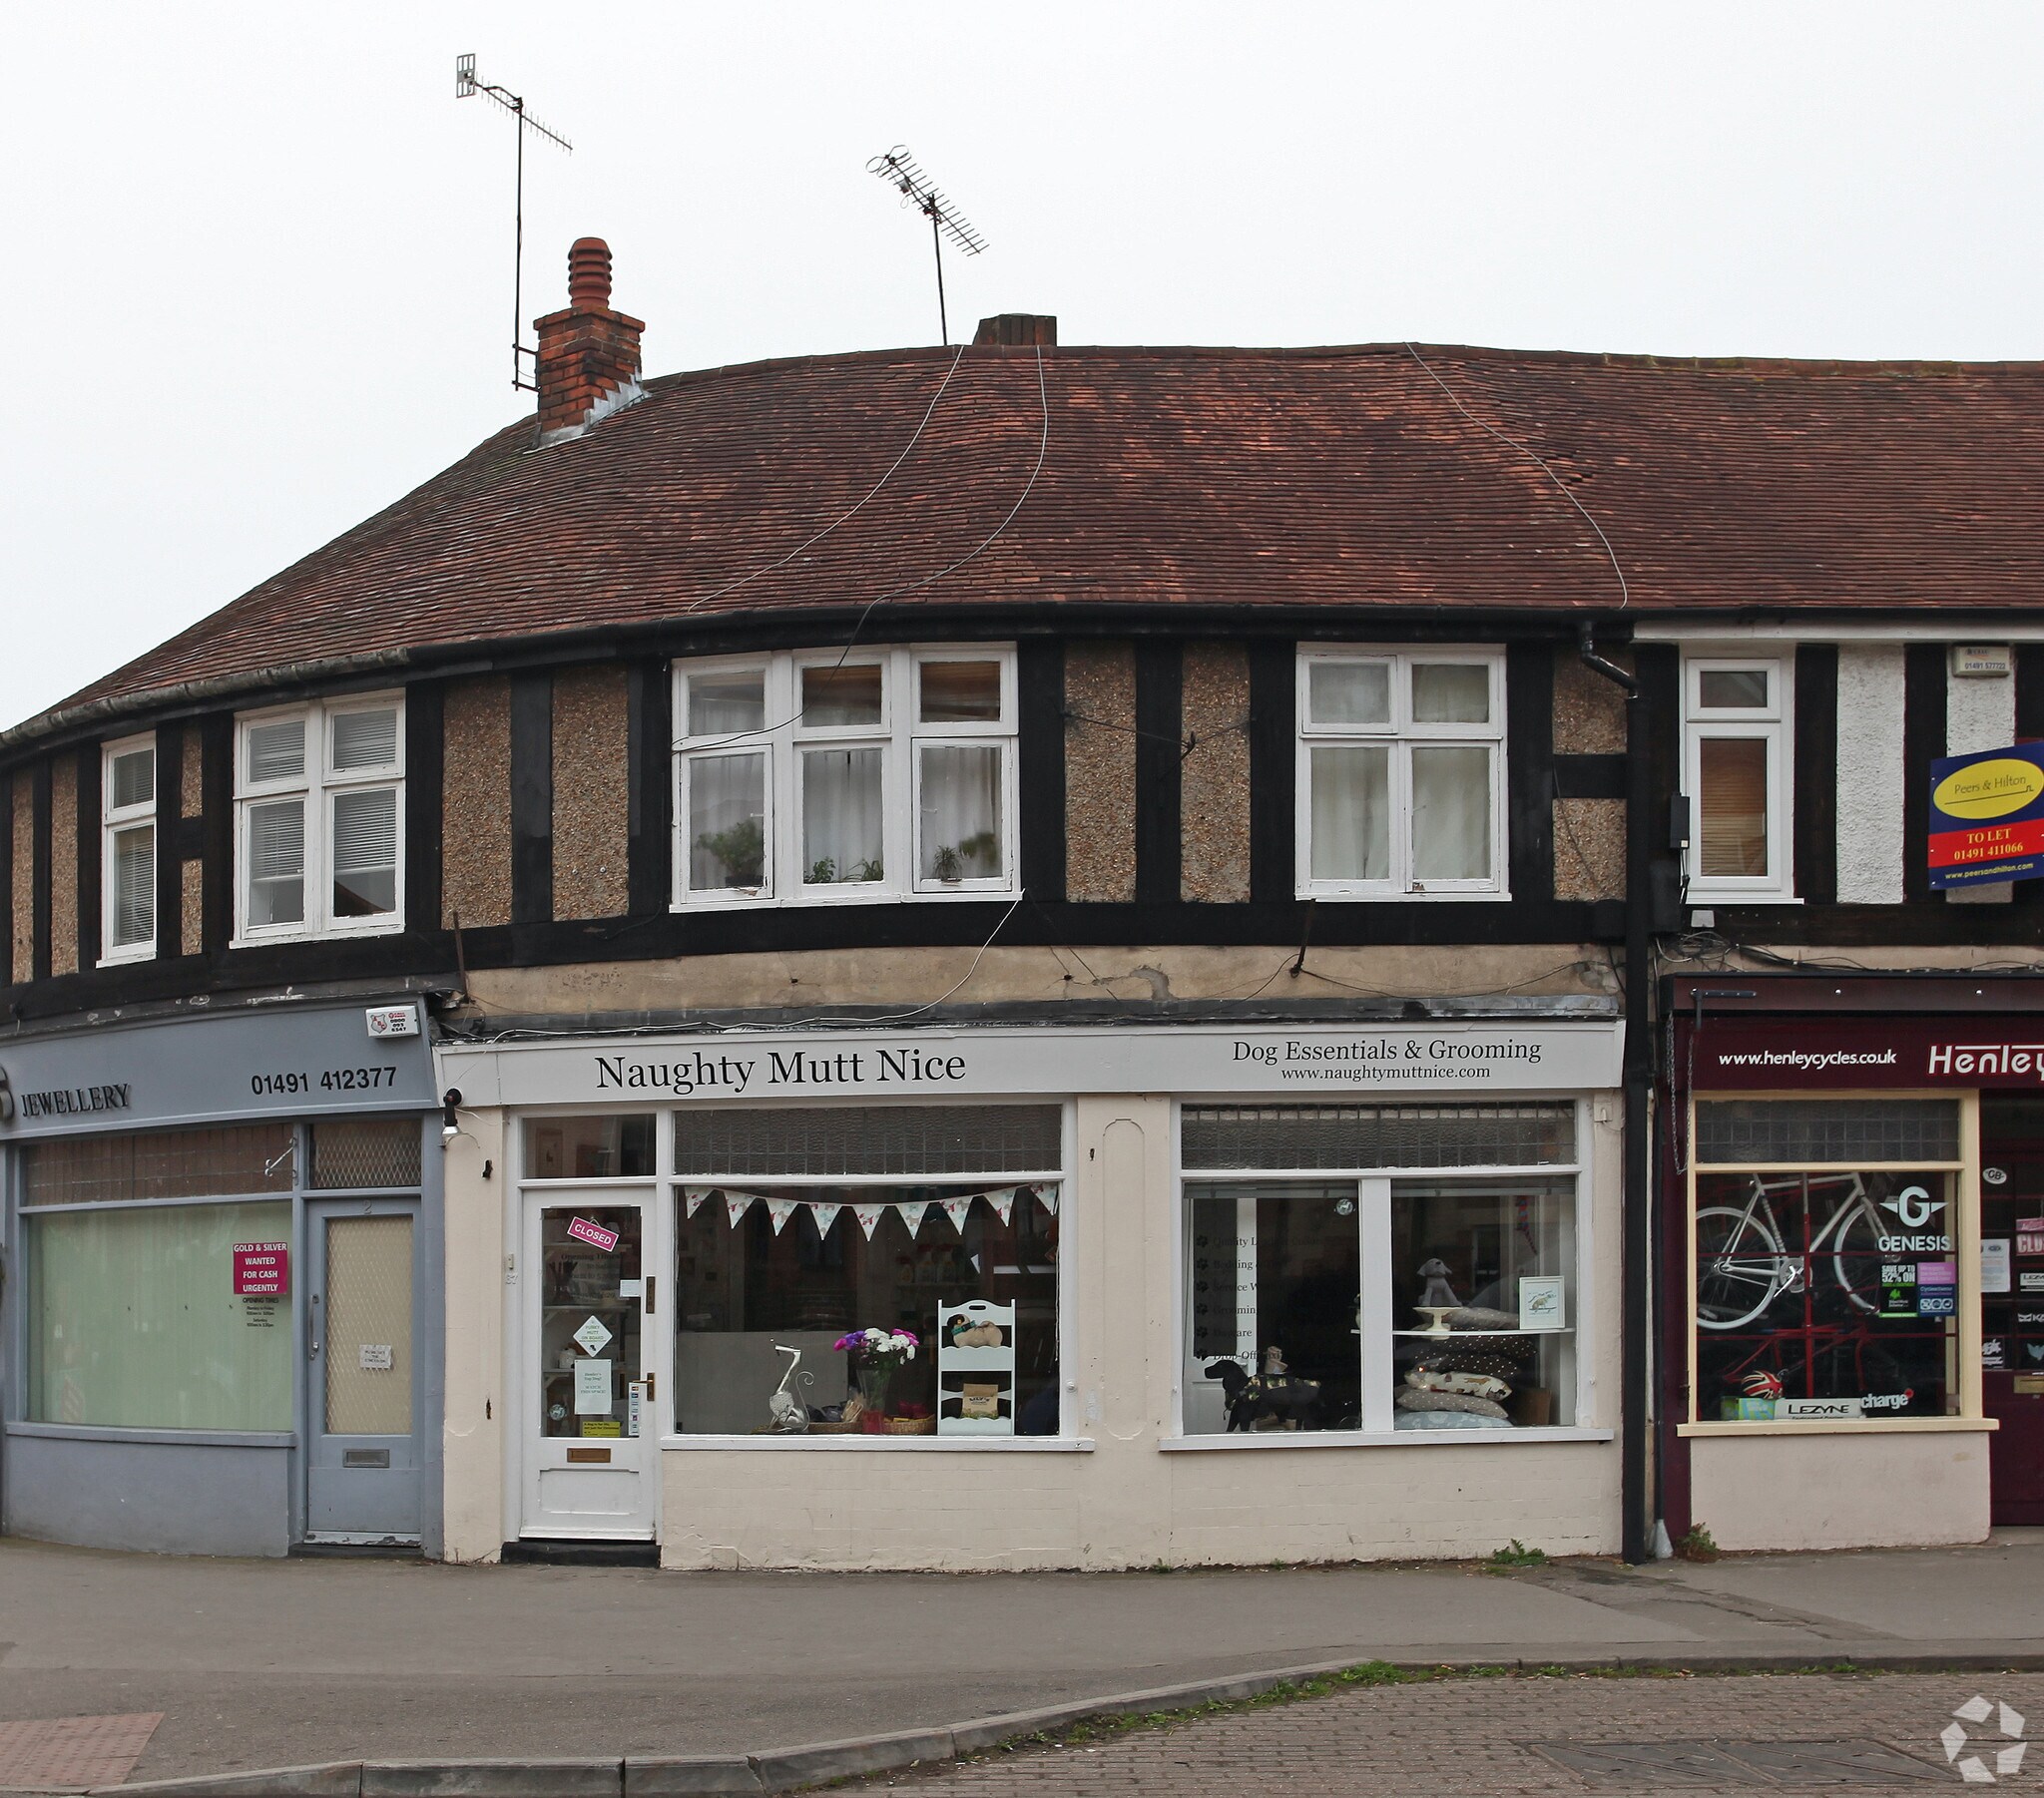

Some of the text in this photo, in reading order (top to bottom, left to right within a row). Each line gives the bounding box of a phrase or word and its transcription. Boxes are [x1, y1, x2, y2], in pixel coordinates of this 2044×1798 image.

[1954, 774, 2027, 794] Peers & Hilton
[1966, 828, 2012, 844] TO LET
[1953, 842, 2025, 861] 01491 411066
[1945, 863, 2034, 879] www.peersandhilton.com
[1233, 1038, 1542, 1065] Dog Essentials & Grooming
[1719, 1050, 1897, 1071] www.henleycycles.co.uk
[251, 1066, 397, 1096] 01491 412377
[595, 1048, 966, 1095] Naughty Mutt Nice
[1280, 1063, 1491, 1083] www.naughtymuttnice.com
[21, 1083, 129, 1118] JEWELLERY
[363, 1199, 373, 1214] 2
[1899, 1185, 1930, 1227] G
[575, 1223, 612, 1244] CLOSED
[1878, 1235, 1951, 1252] GENESIS
[2017, 1233, 2044, 1253] CLO
[1881, 1272, 1901, 1283] 52%
[1902, 1272, 1915, 1283] ON
[1788, 1404, 1849, 1414] LEZYNE
[1861, 1393, 1908, 1409] charge
